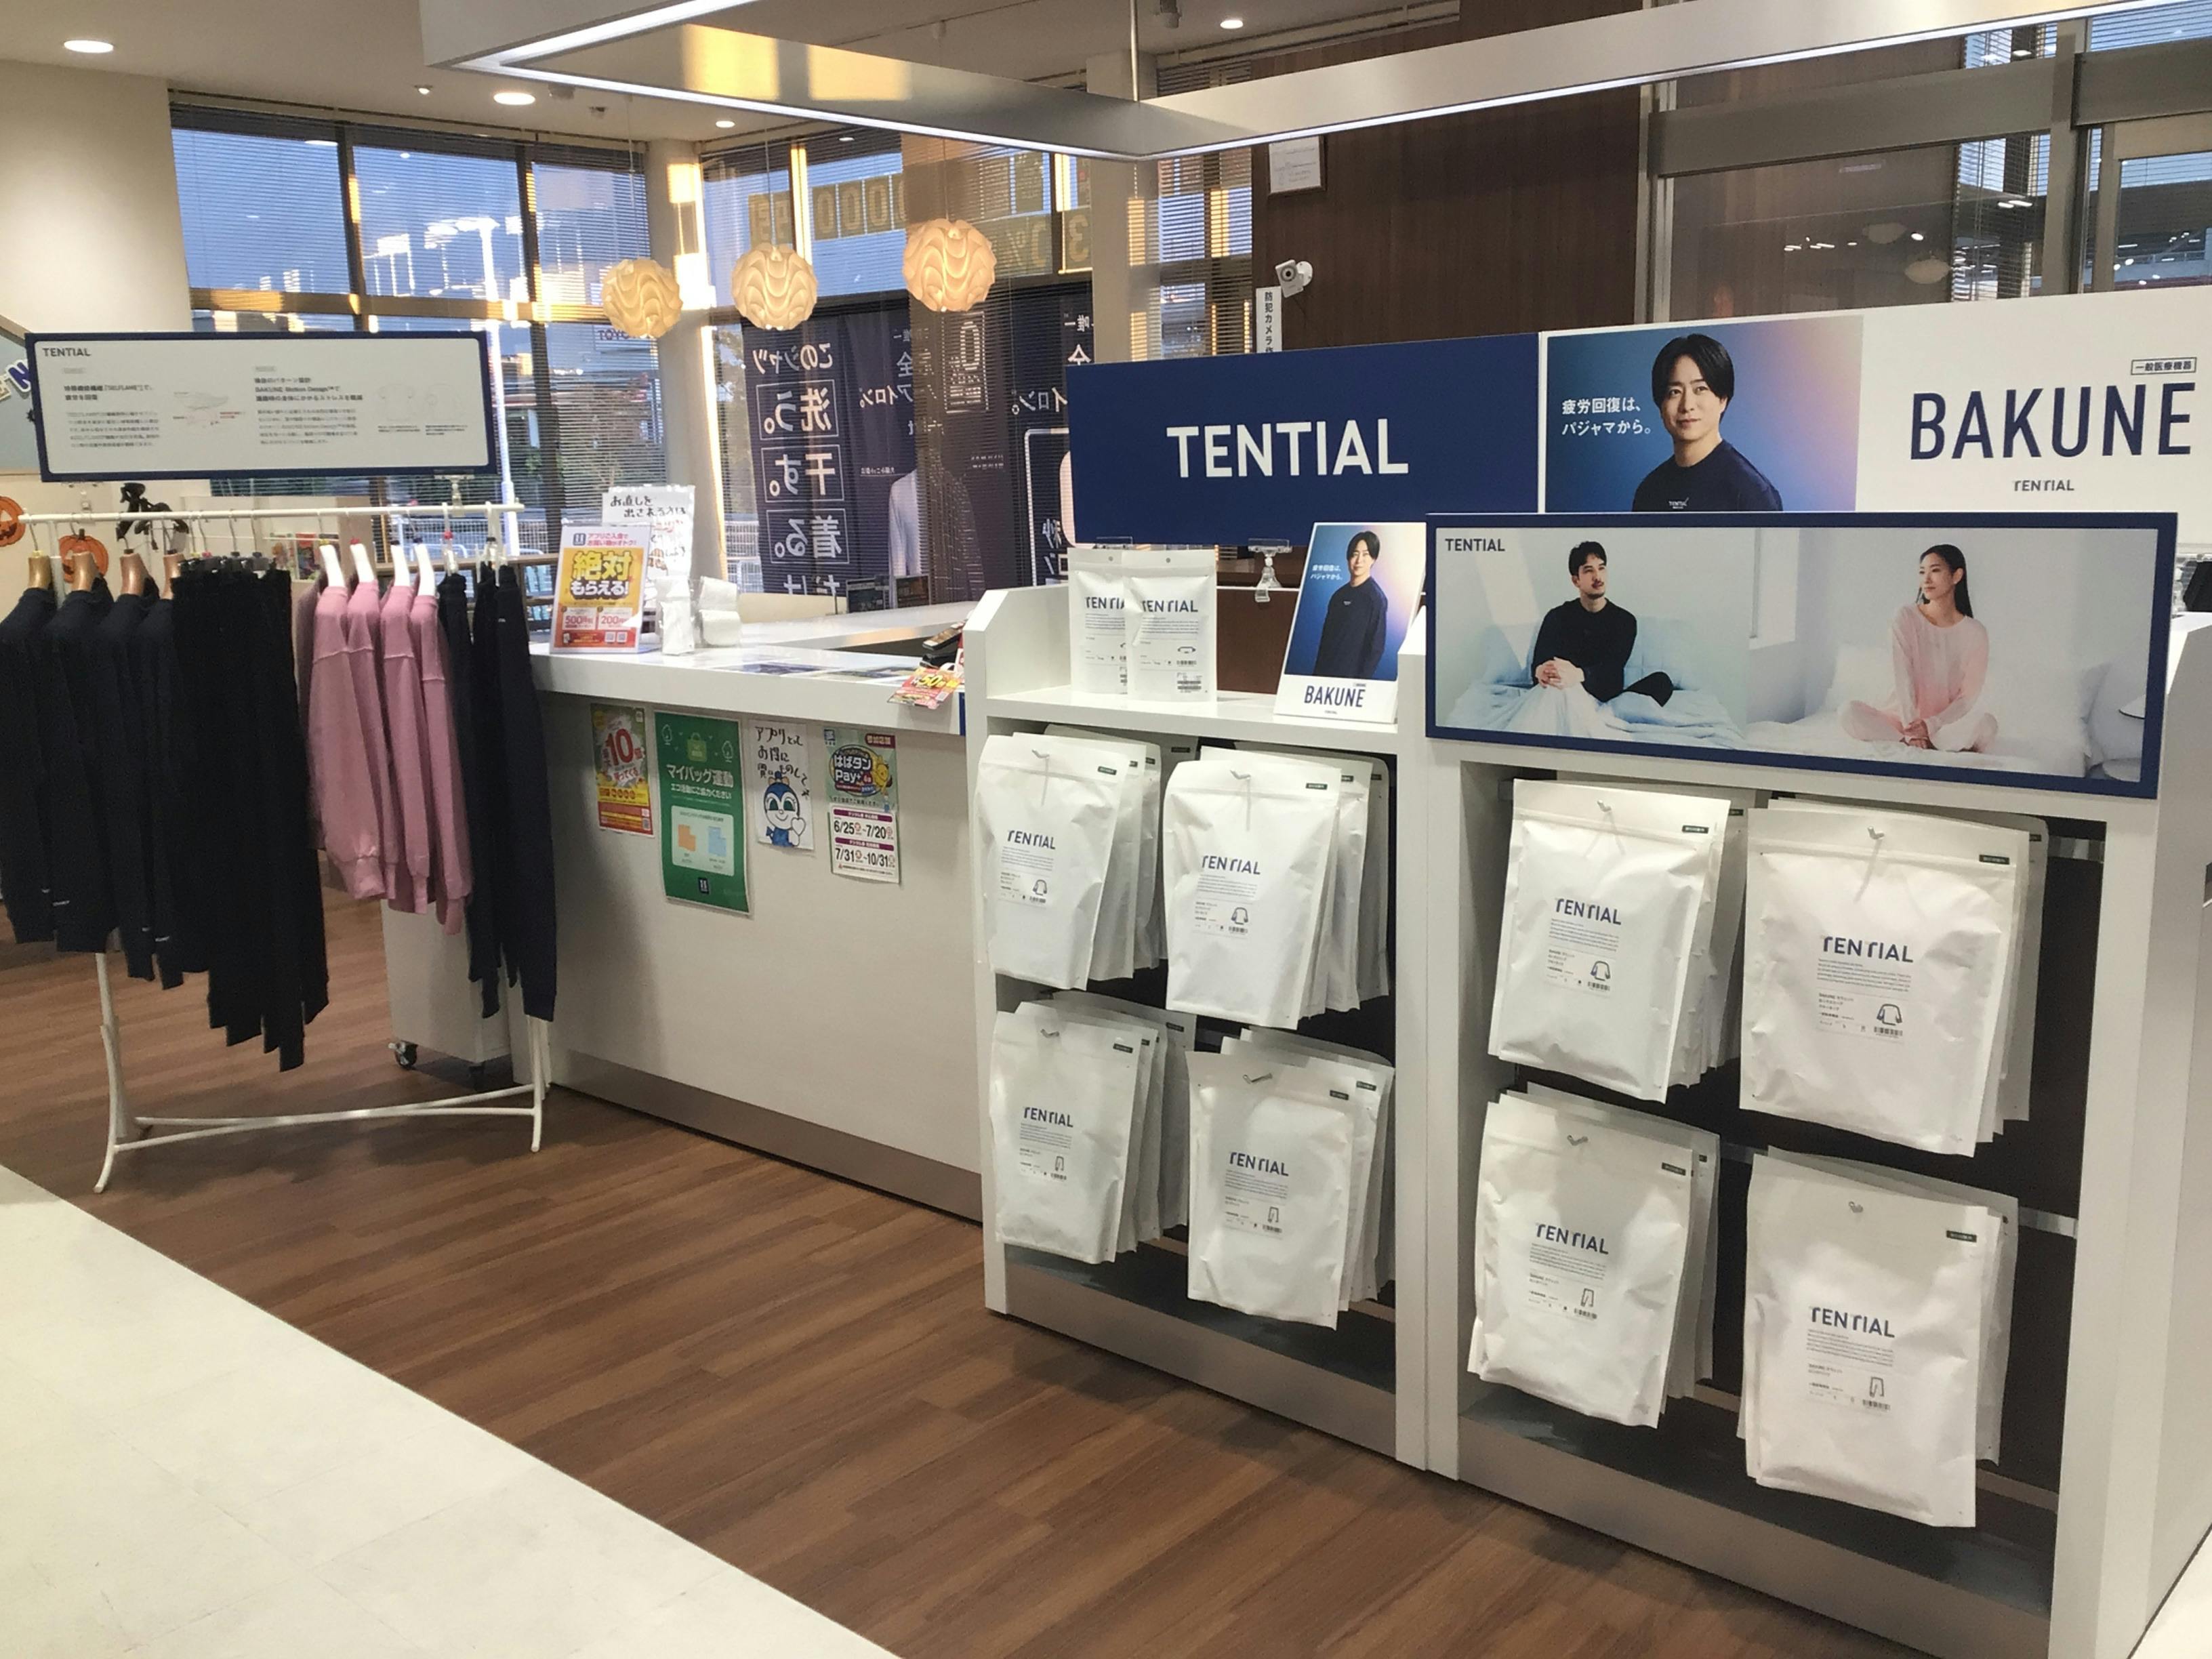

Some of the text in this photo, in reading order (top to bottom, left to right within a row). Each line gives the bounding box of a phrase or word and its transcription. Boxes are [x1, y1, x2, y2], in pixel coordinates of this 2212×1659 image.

[43, 348, 91, 357] TENTIAL
[1562, 397, 1641, 415] 疲労回復は、
[1561, 419, 1651, 436] パジャマから。
[1911, 382, 2196, 460] BAKUNE
[1167, 418, 1409, 478] TENTIAL
[2013, 479, 2075, 493] TENTIAL
[1445, 538, 1506, 552] TENTIAL
[572, 550, 633, 581] 絶対
[571, 581, 629, 596] もらえる!
[1142, 600, 1199, 613] TENTIAL
[1304, 685, 1366, 708] BAKUNE
[834, 754, 871, 769] はばタン
[666, 764, 733, 787] マイバッグ運動
[834, 820, 855, 835] 6/25
[1007, 830, 1057, 850] TENTIAL
[835, 847, 854, 862] 7/31
[1201, 855, 1261, 875] TENTIAL
[1555, 898, 1621, 925] TENTIAL
[1821, 935, 1914, 962] TENTIAL
[1023, 1107, 1074, 1128] TENTIAL
[1229, 1152, 1289, 1176] TENTIAL
[1536, 1223, 1609, 1254] TENTIAL
[1809, 1307, 1895, 1338] TENTIAL
